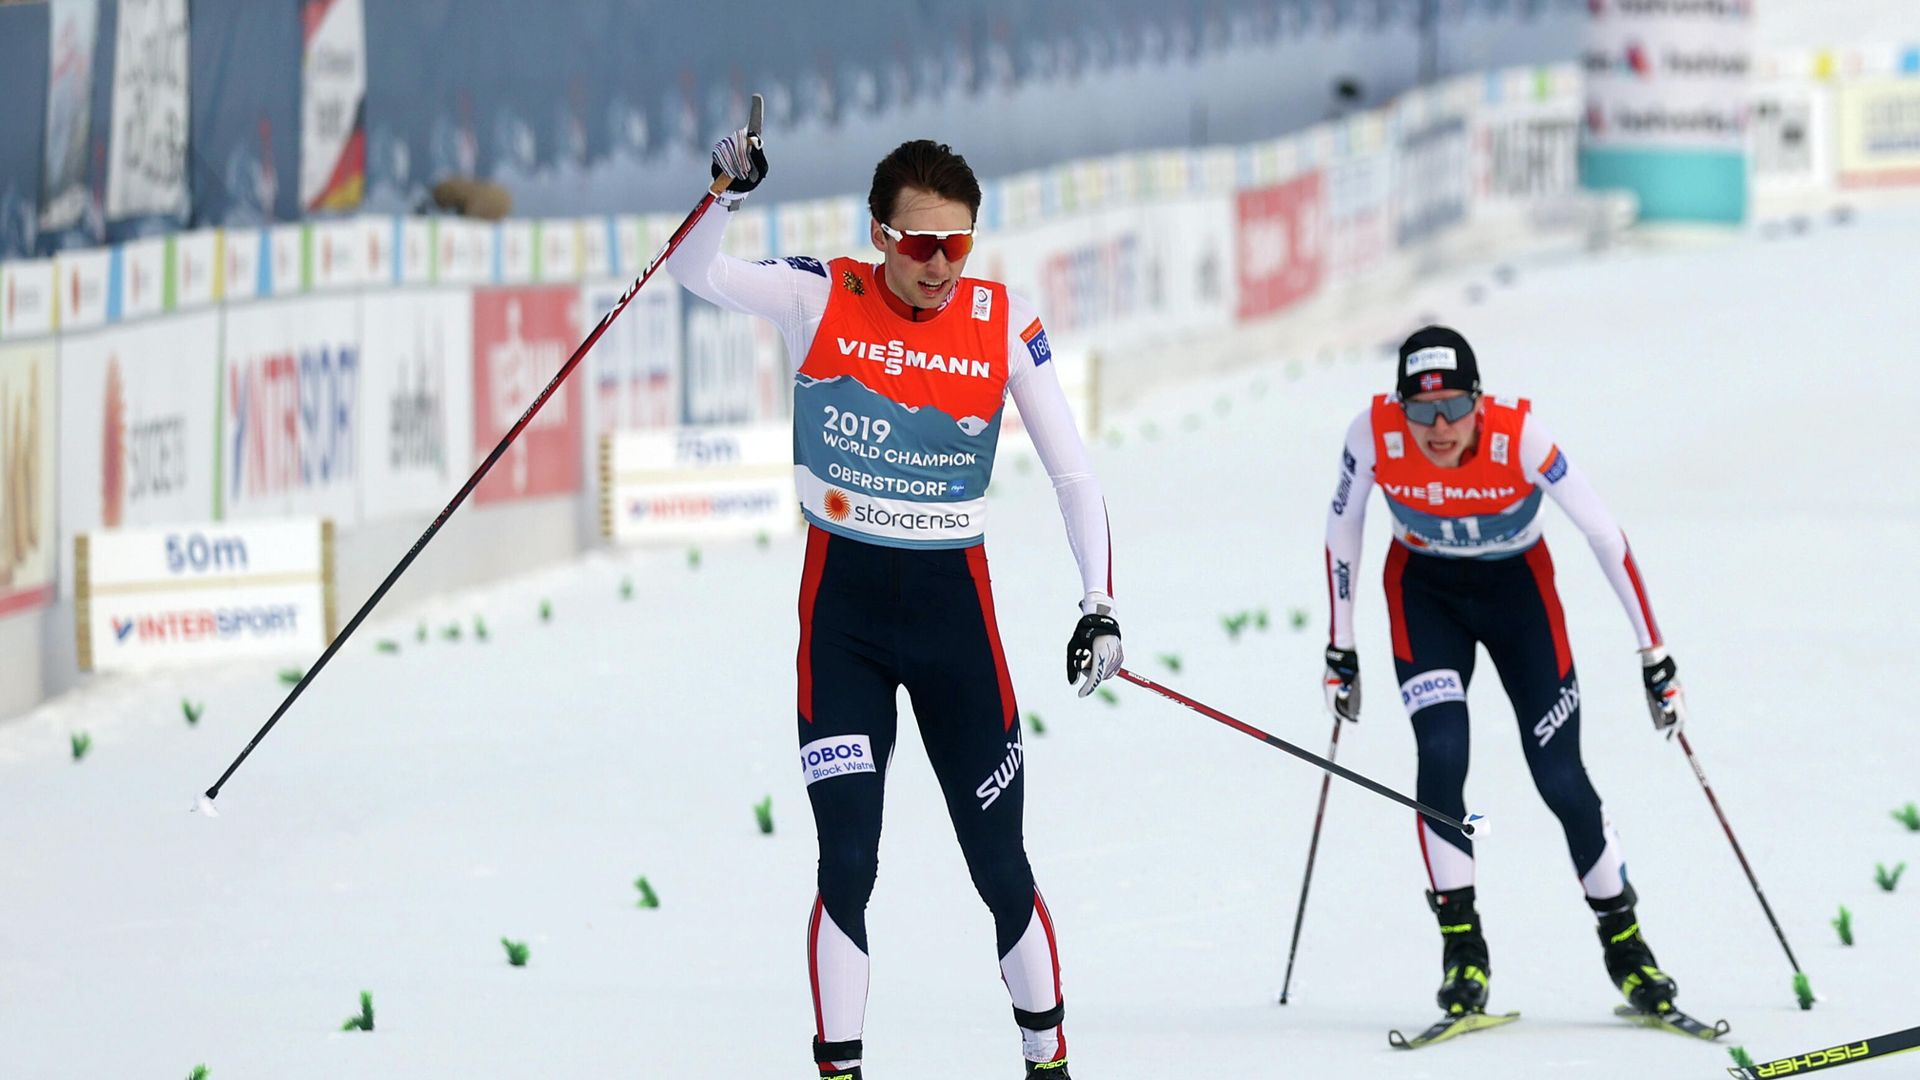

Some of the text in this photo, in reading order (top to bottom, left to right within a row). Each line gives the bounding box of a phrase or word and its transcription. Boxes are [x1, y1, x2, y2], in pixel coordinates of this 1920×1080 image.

[836, 337, 991, 379] VIESSMANN
[823, 405, 892, 444] 2019
[823, 432, 977, 467] WORLD CHAMPION
[828, 463, 948, 496] OBERSTDORF
[1384, 481, 1516, 506] VIESSMANN
[1440, 516, 1482, 540] 11
[165, 533, 248, 574] 50m
[137, 603, 299, 643] INTERSPORT
[1412, 677, 1456, 697] OBOS
[808, 743, 863, 766] OBOS
[812, 761, 875, 779] Block Watne
[1756, 1041, 1870, 1078] FISCHER
